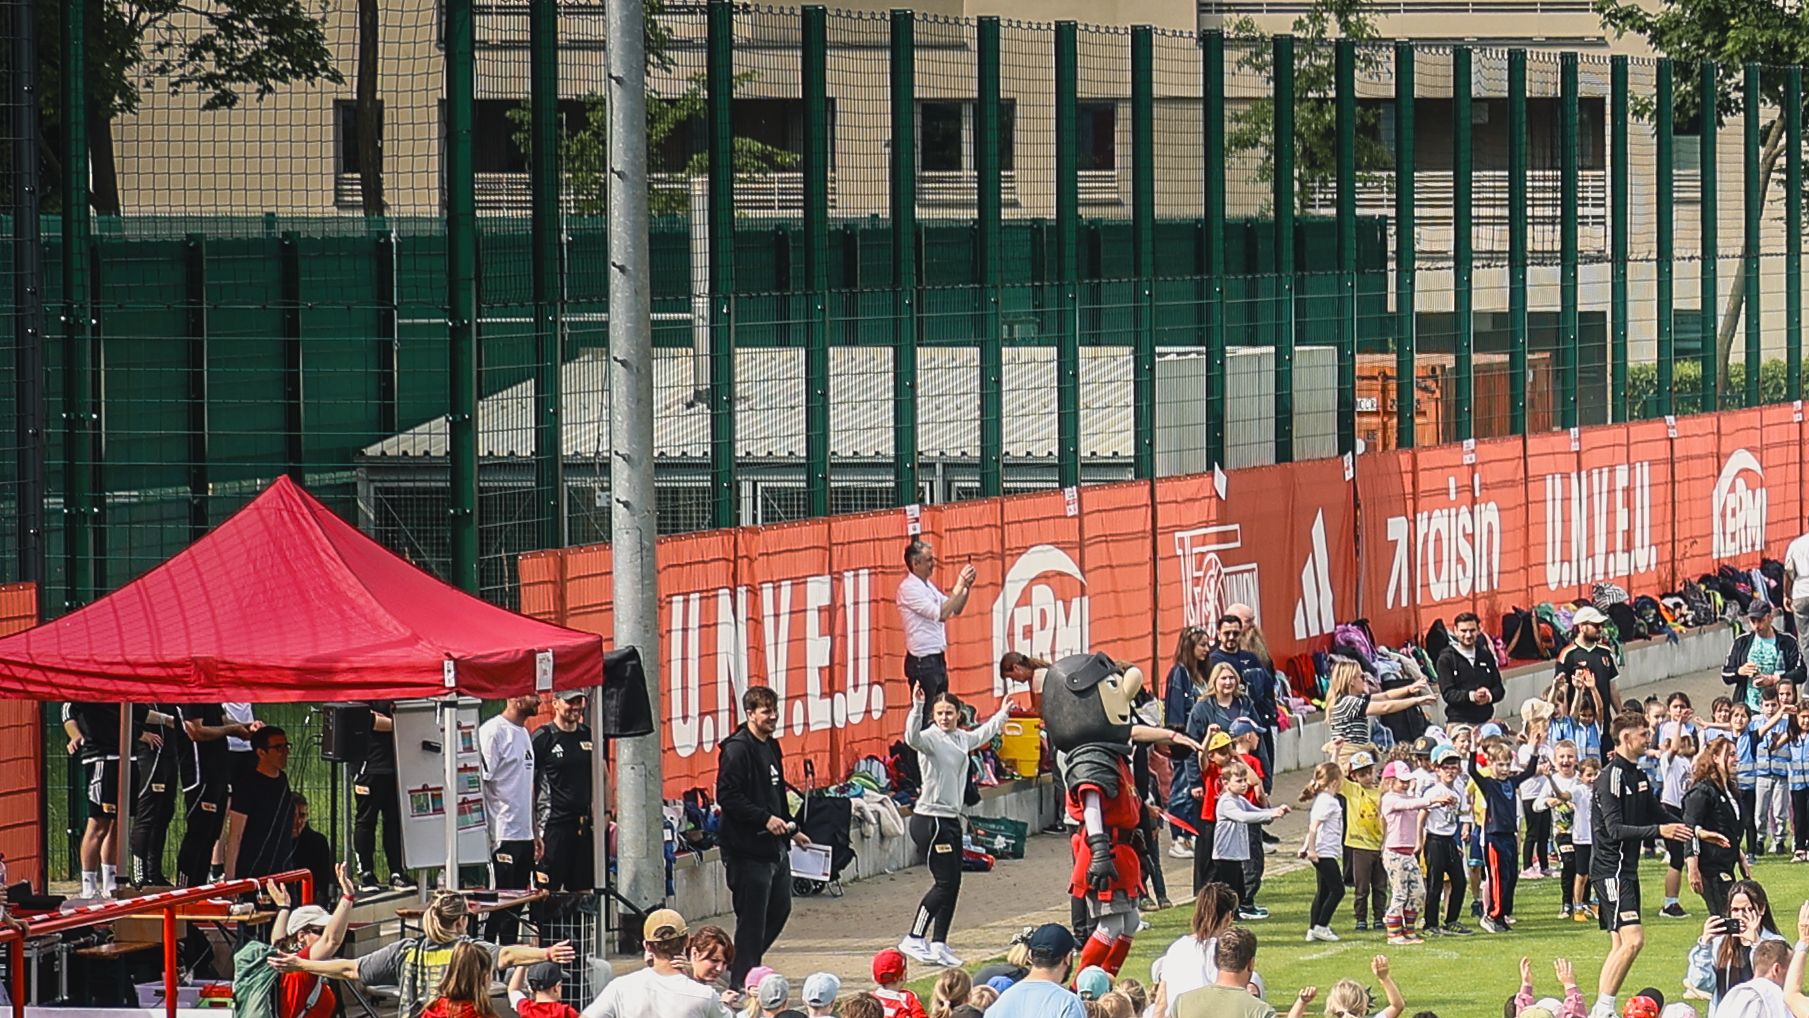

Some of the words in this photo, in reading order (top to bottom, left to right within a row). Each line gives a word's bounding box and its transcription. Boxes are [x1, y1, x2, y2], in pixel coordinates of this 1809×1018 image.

[1416, 472, 1501, 604] raisin
[1545, 461, 1657, 591] U.N.V.E.U.
[1711, 448, 1767, 560] KERMI
[668, 568, 886, 758] U.N.V.E.U.
